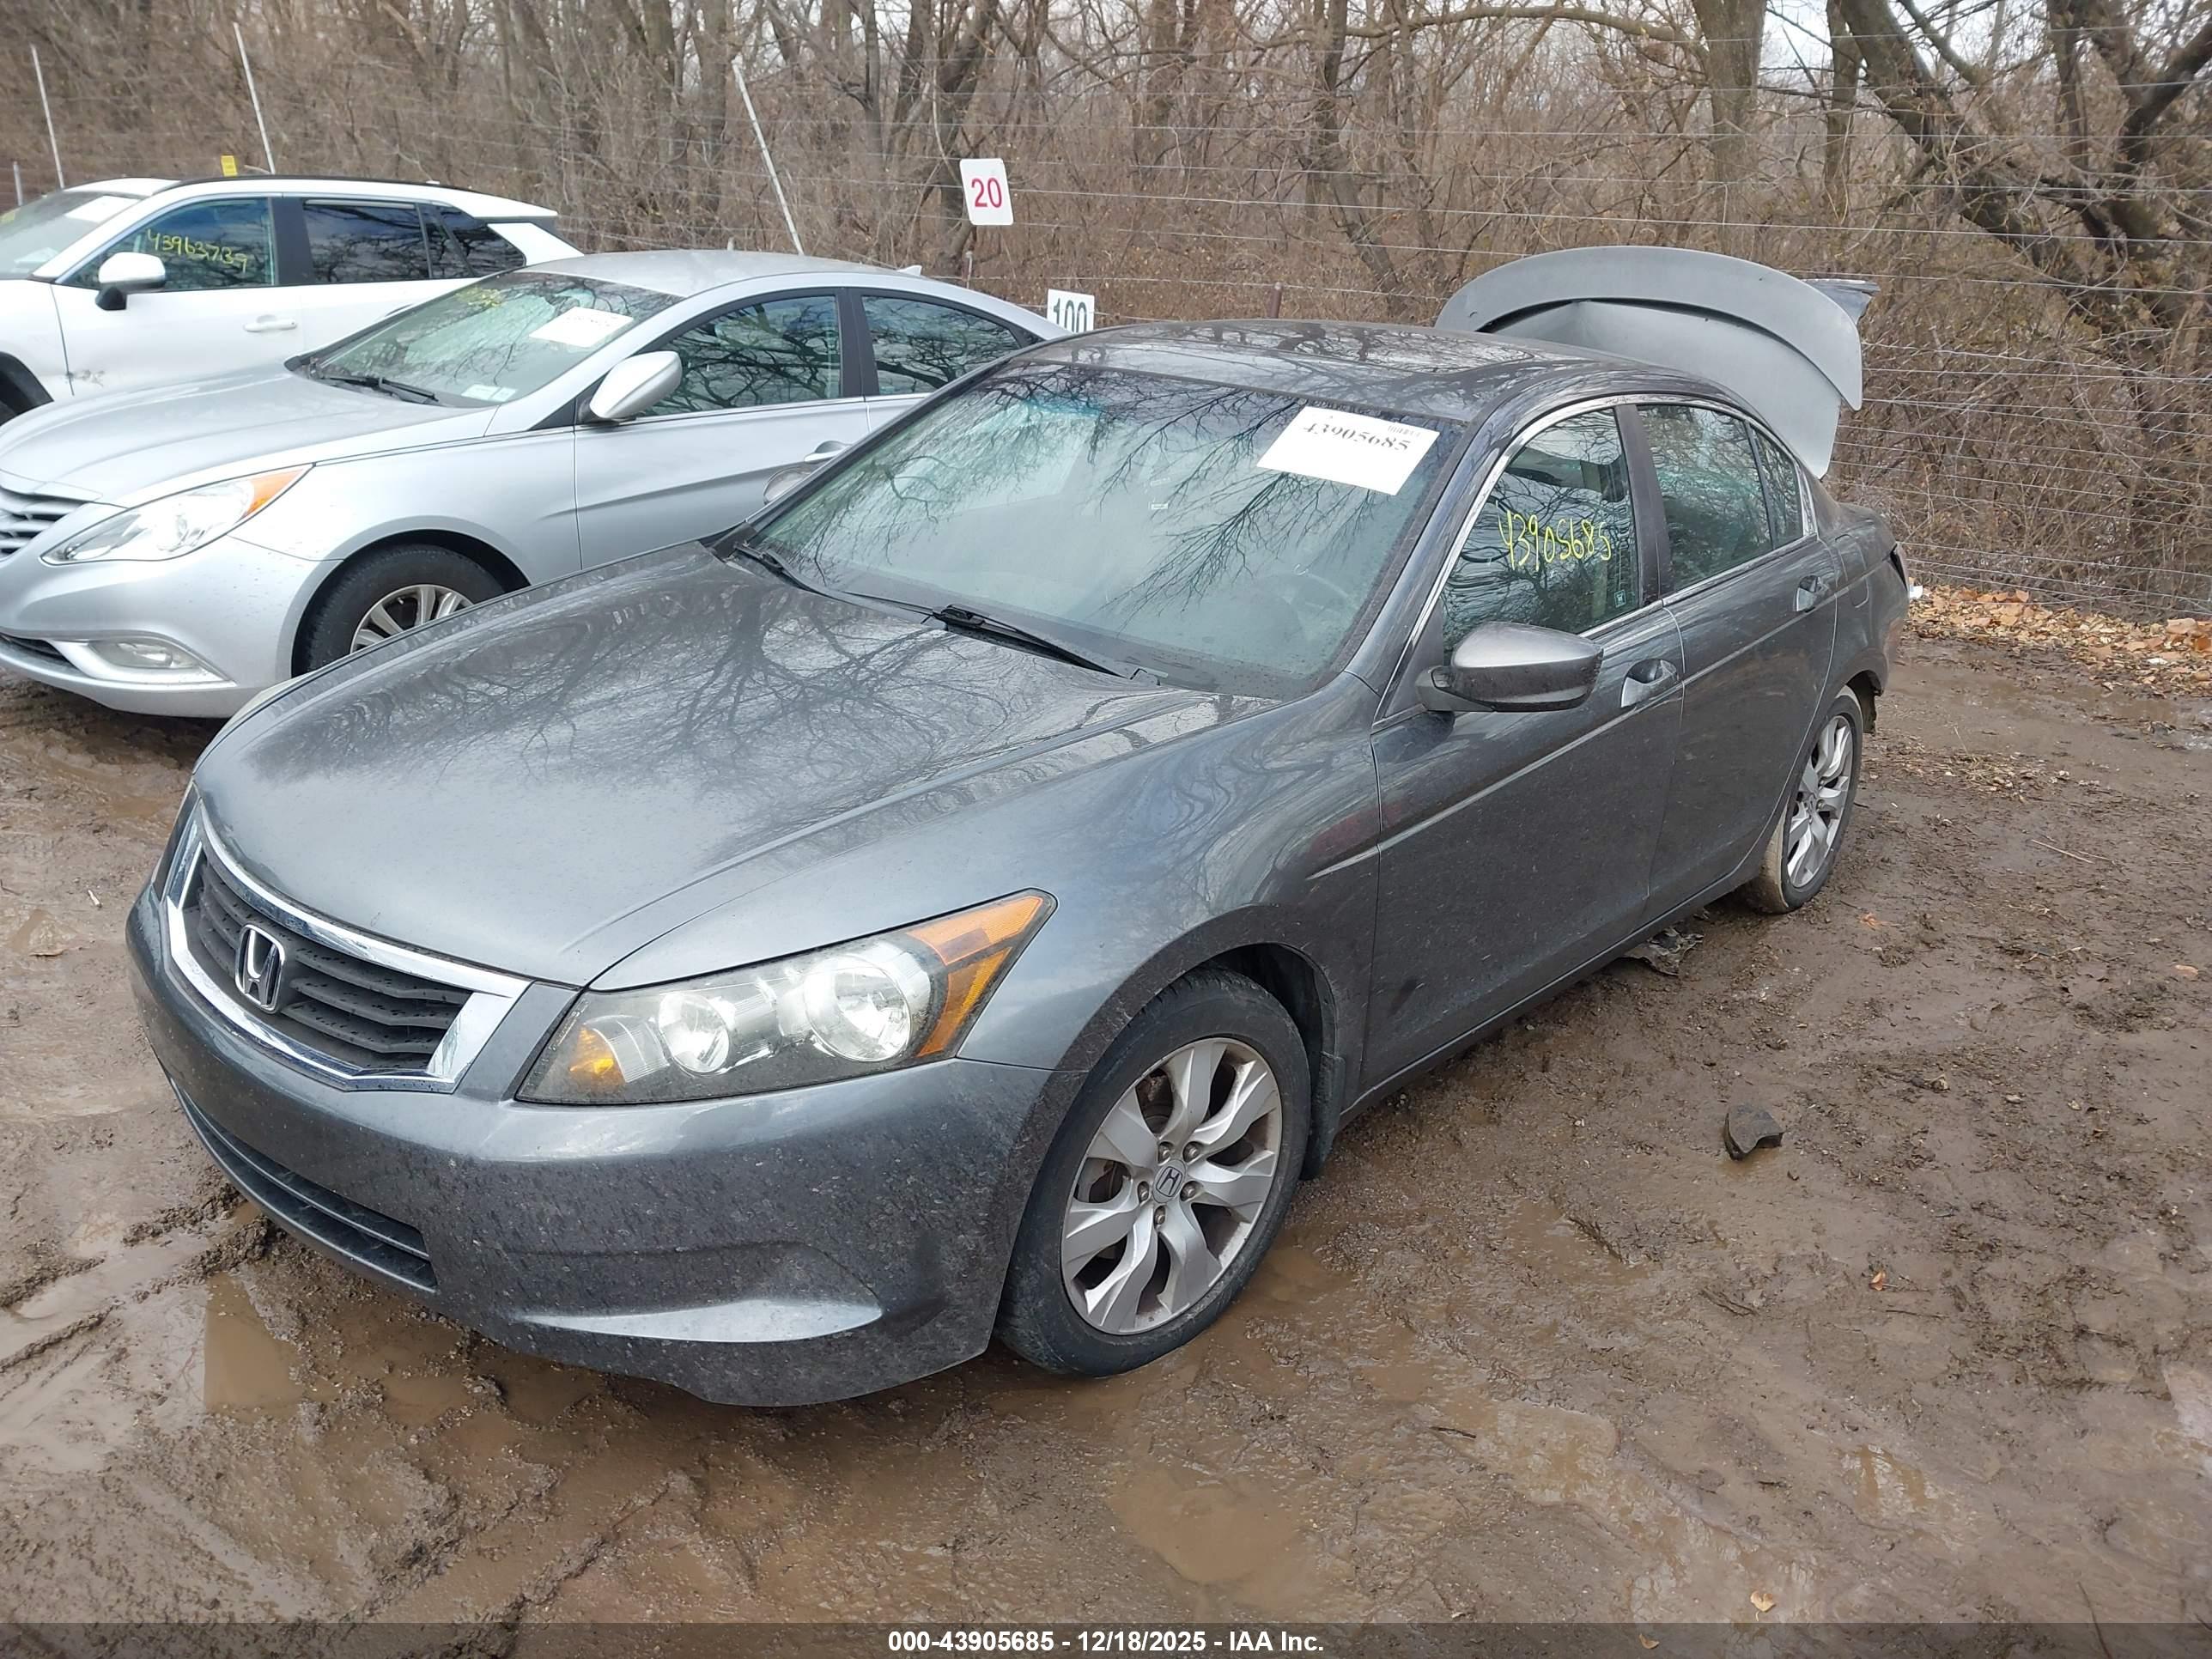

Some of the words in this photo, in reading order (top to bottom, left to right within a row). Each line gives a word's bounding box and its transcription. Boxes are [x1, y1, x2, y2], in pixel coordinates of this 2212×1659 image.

[971, 177, 1003, 208] 20
[1053, 297, 1088, 333] 100
[1303, 422, 1412, 452] 43905685
[1496, 501, 1612, 572] 43905685
